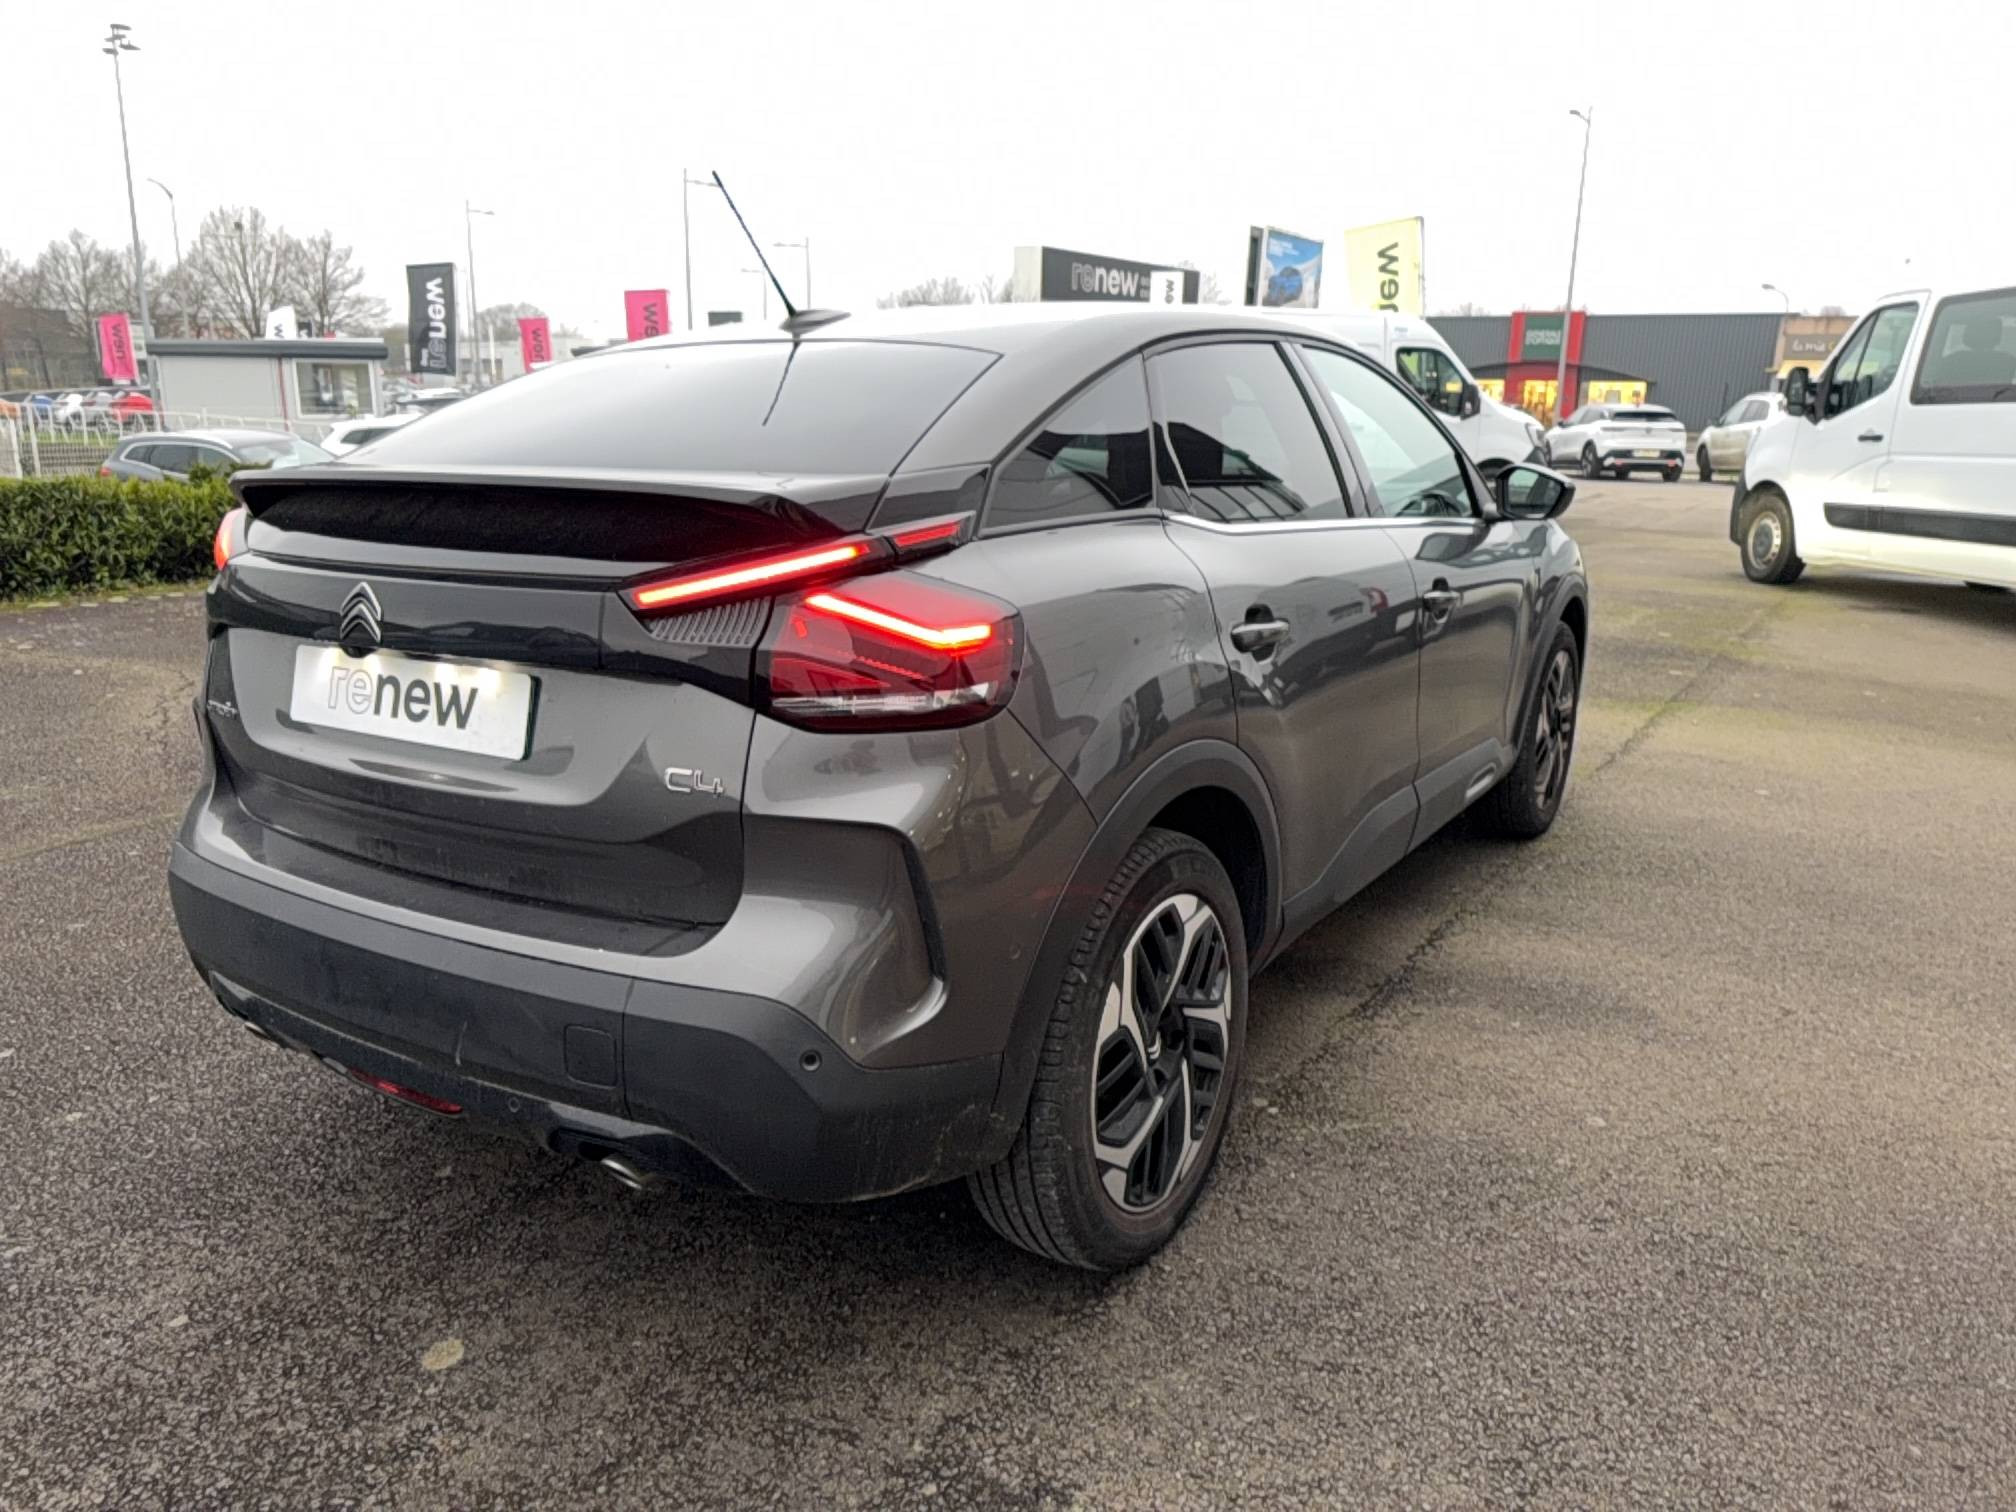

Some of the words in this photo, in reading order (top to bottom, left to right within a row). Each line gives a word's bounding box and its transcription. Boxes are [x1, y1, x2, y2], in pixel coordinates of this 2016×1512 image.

[1071, 262, 1139, 297] renew
[328, 666, 478, 730] renew
[664, 767, 724, 798] C4
